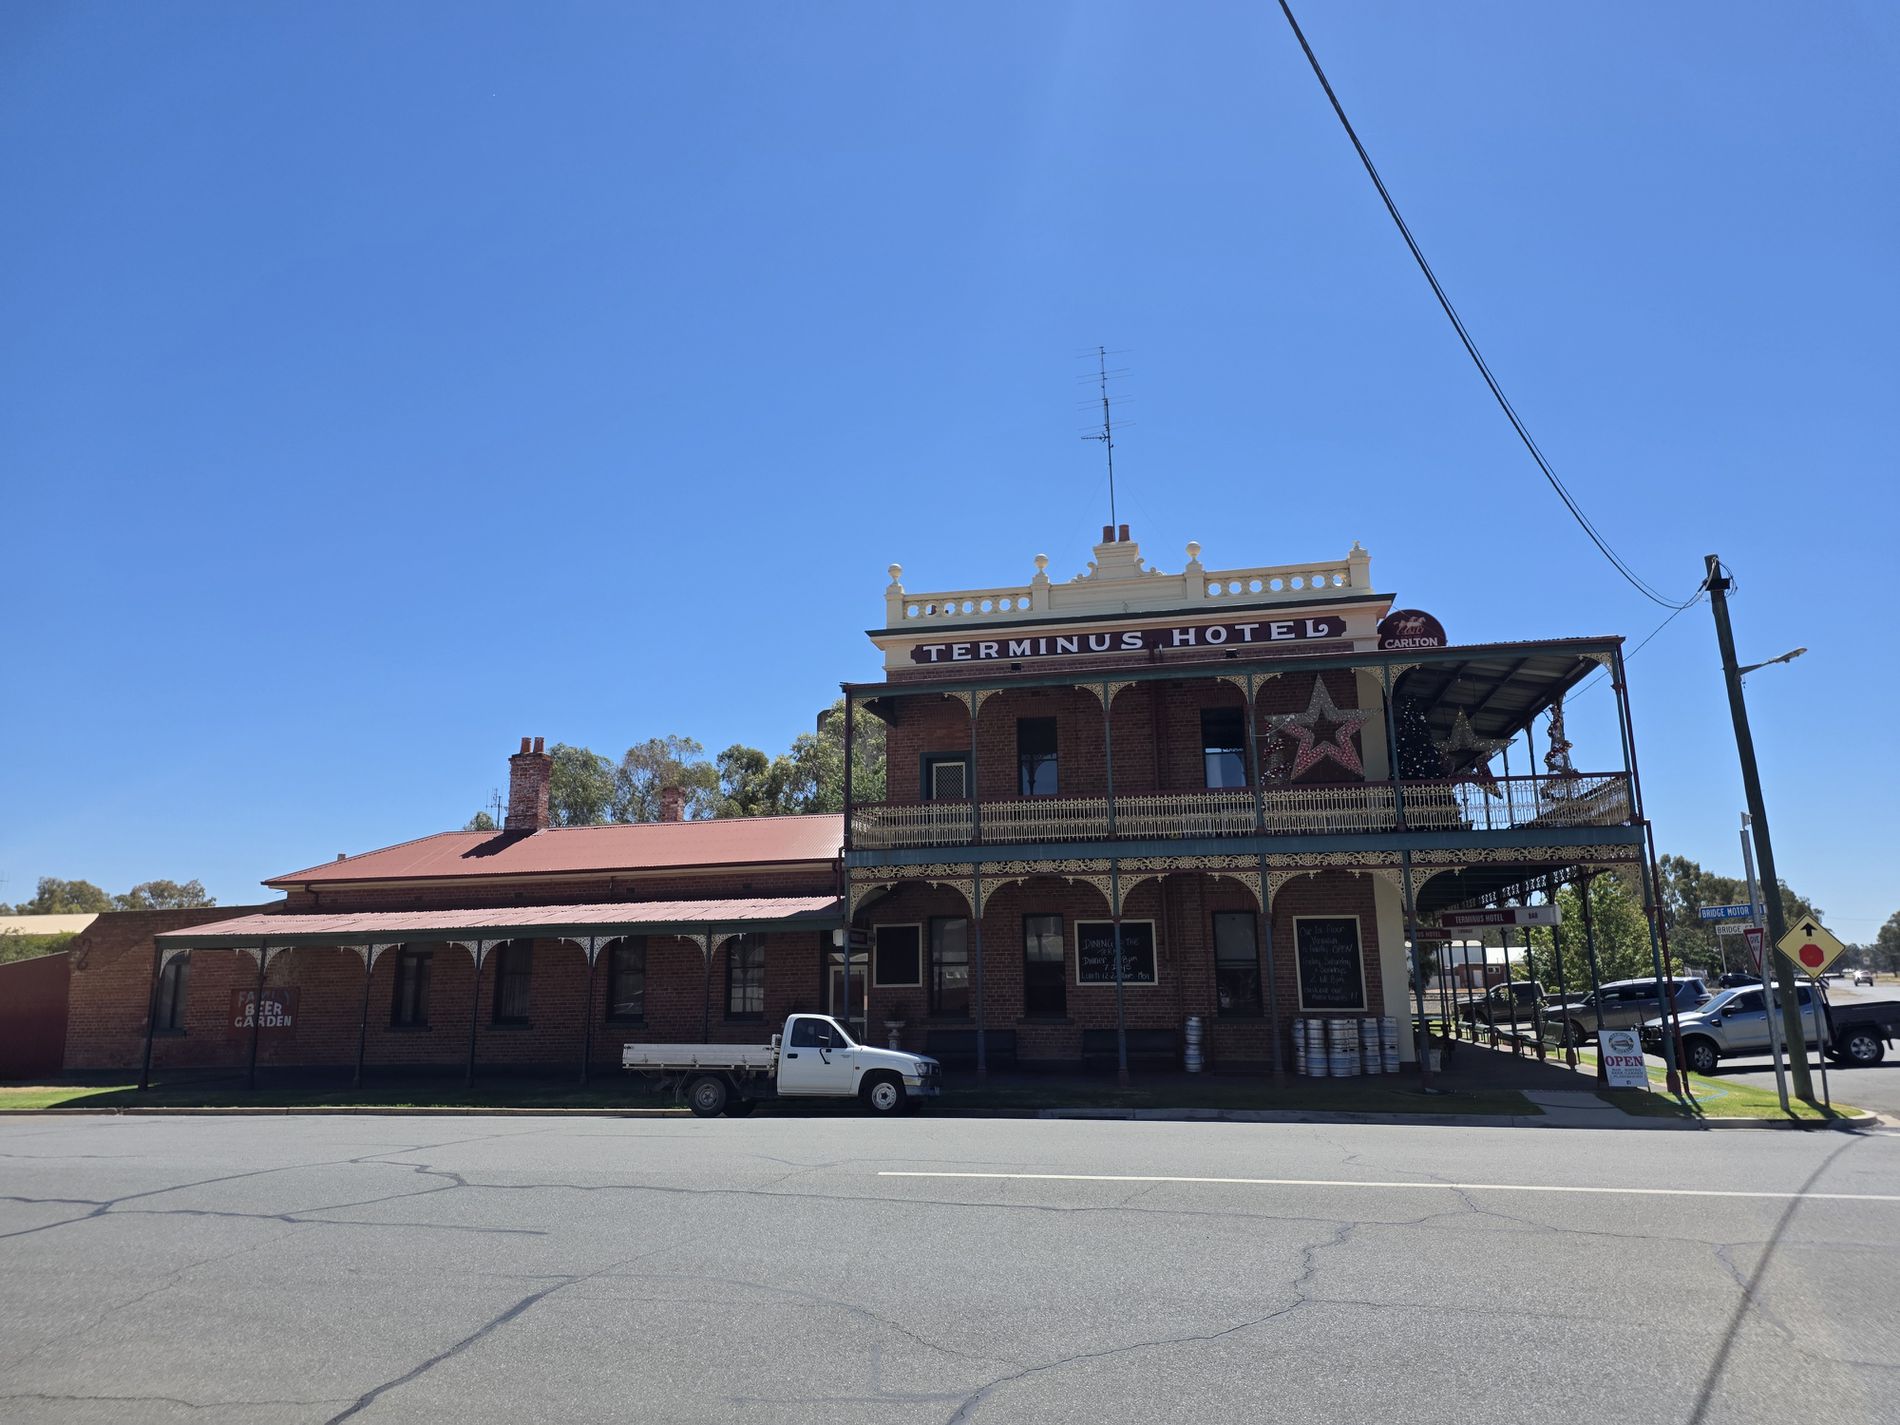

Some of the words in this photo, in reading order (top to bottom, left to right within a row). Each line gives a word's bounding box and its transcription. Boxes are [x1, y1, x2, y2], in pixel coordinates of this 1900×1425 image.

[922, 631, 1144, 662] TERMINUS
[1170, 619, 1330, 647] HOTEL
[1384, 637, 1438, 649] CARLTON
[1701, 908, 1726, 918] BRIDGE
[1727, 906, 1750, 916] MOTOR
[1455, 914, 1485, 925] TERMINUS
[1485, 912, 1505, 922] HOTEL
[1716, 925, 1742, 935] BRIDGE
[1750, 935, 1760, 944] GIVE
[245, 1000, 282, 1016] BEER
[234, 1015, 292, 1028] GARDEN
[1605, 1055, 1643, 1067] OPEN
